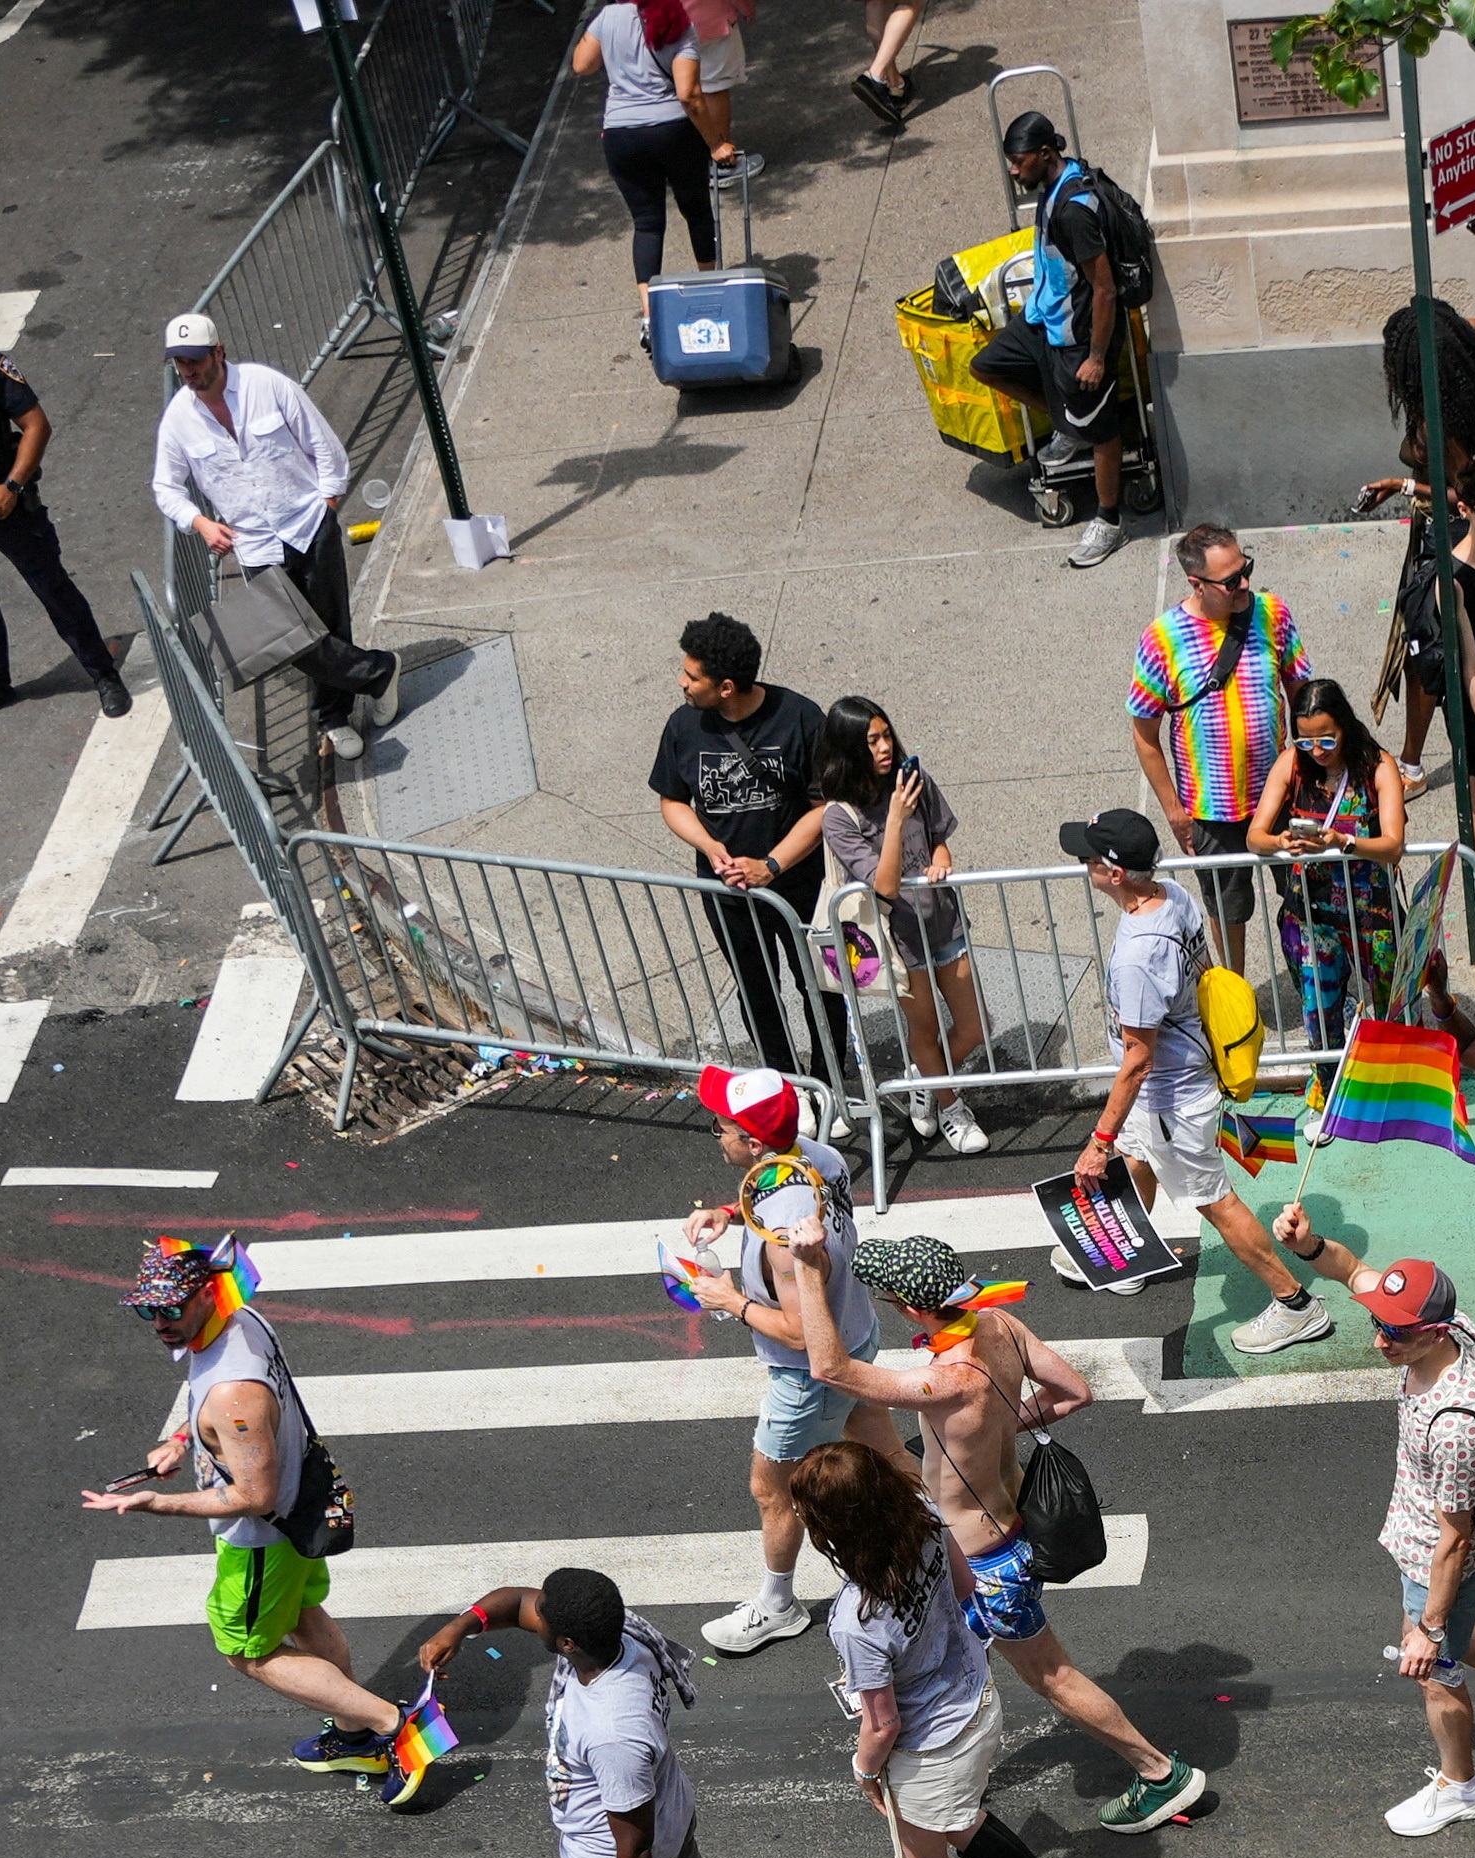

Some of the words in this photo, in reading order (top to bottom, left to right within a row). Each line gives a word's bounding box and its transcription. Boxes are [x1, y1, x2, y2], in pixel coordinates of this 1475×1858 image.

[1249, 28, 1260, 40] 27
[1435, 142, 1453, 165] NO
[179, 325, 189, 338] C
[698, 328, 712, 344] 3
[1059, 1202, 1107, 1268] MANHATTAN
[1070, 1187, 1128, 1271] WOMANHATTAN
[1091, 1190, 1137, 1261] THEYHATTAN
